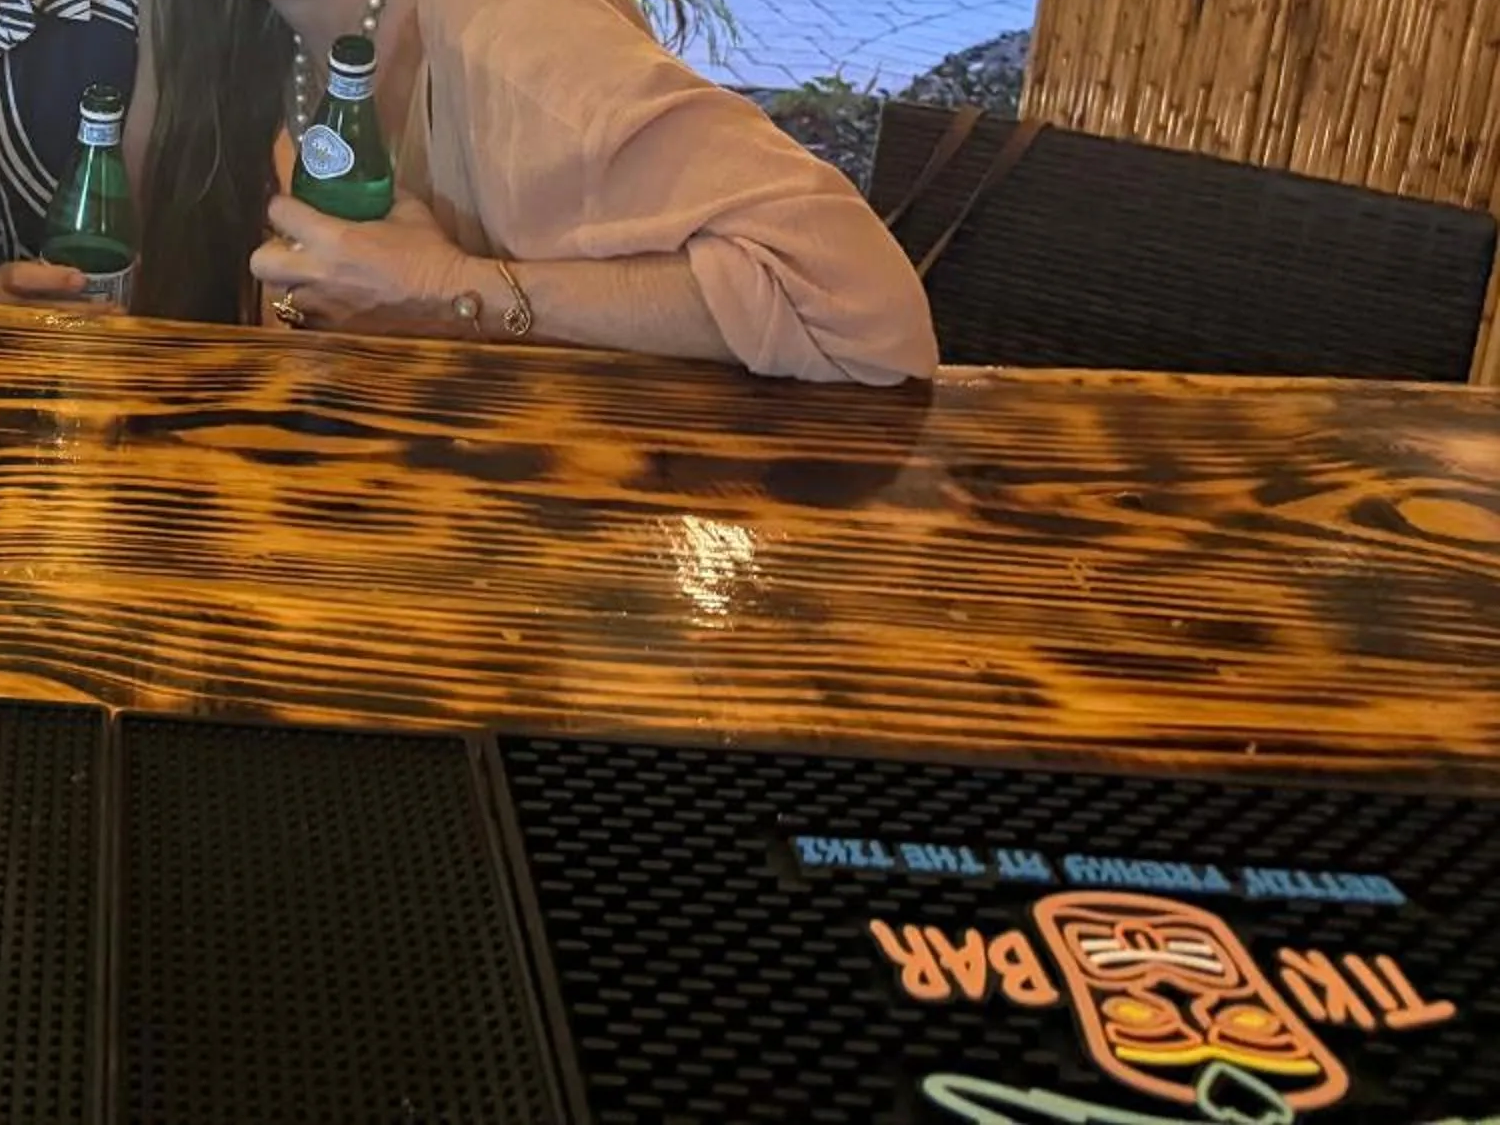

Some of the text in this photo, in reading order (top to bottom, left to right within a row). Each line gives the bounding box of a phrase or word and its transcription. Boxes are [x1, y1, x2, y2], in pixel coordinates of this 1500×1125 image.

[795, 836, 893, 867] TIKI
[902, 842, 986, 875] THE
[998, 848, 1052, 880] AT
[870, 920, 1456, 1029] TIKI BAR
